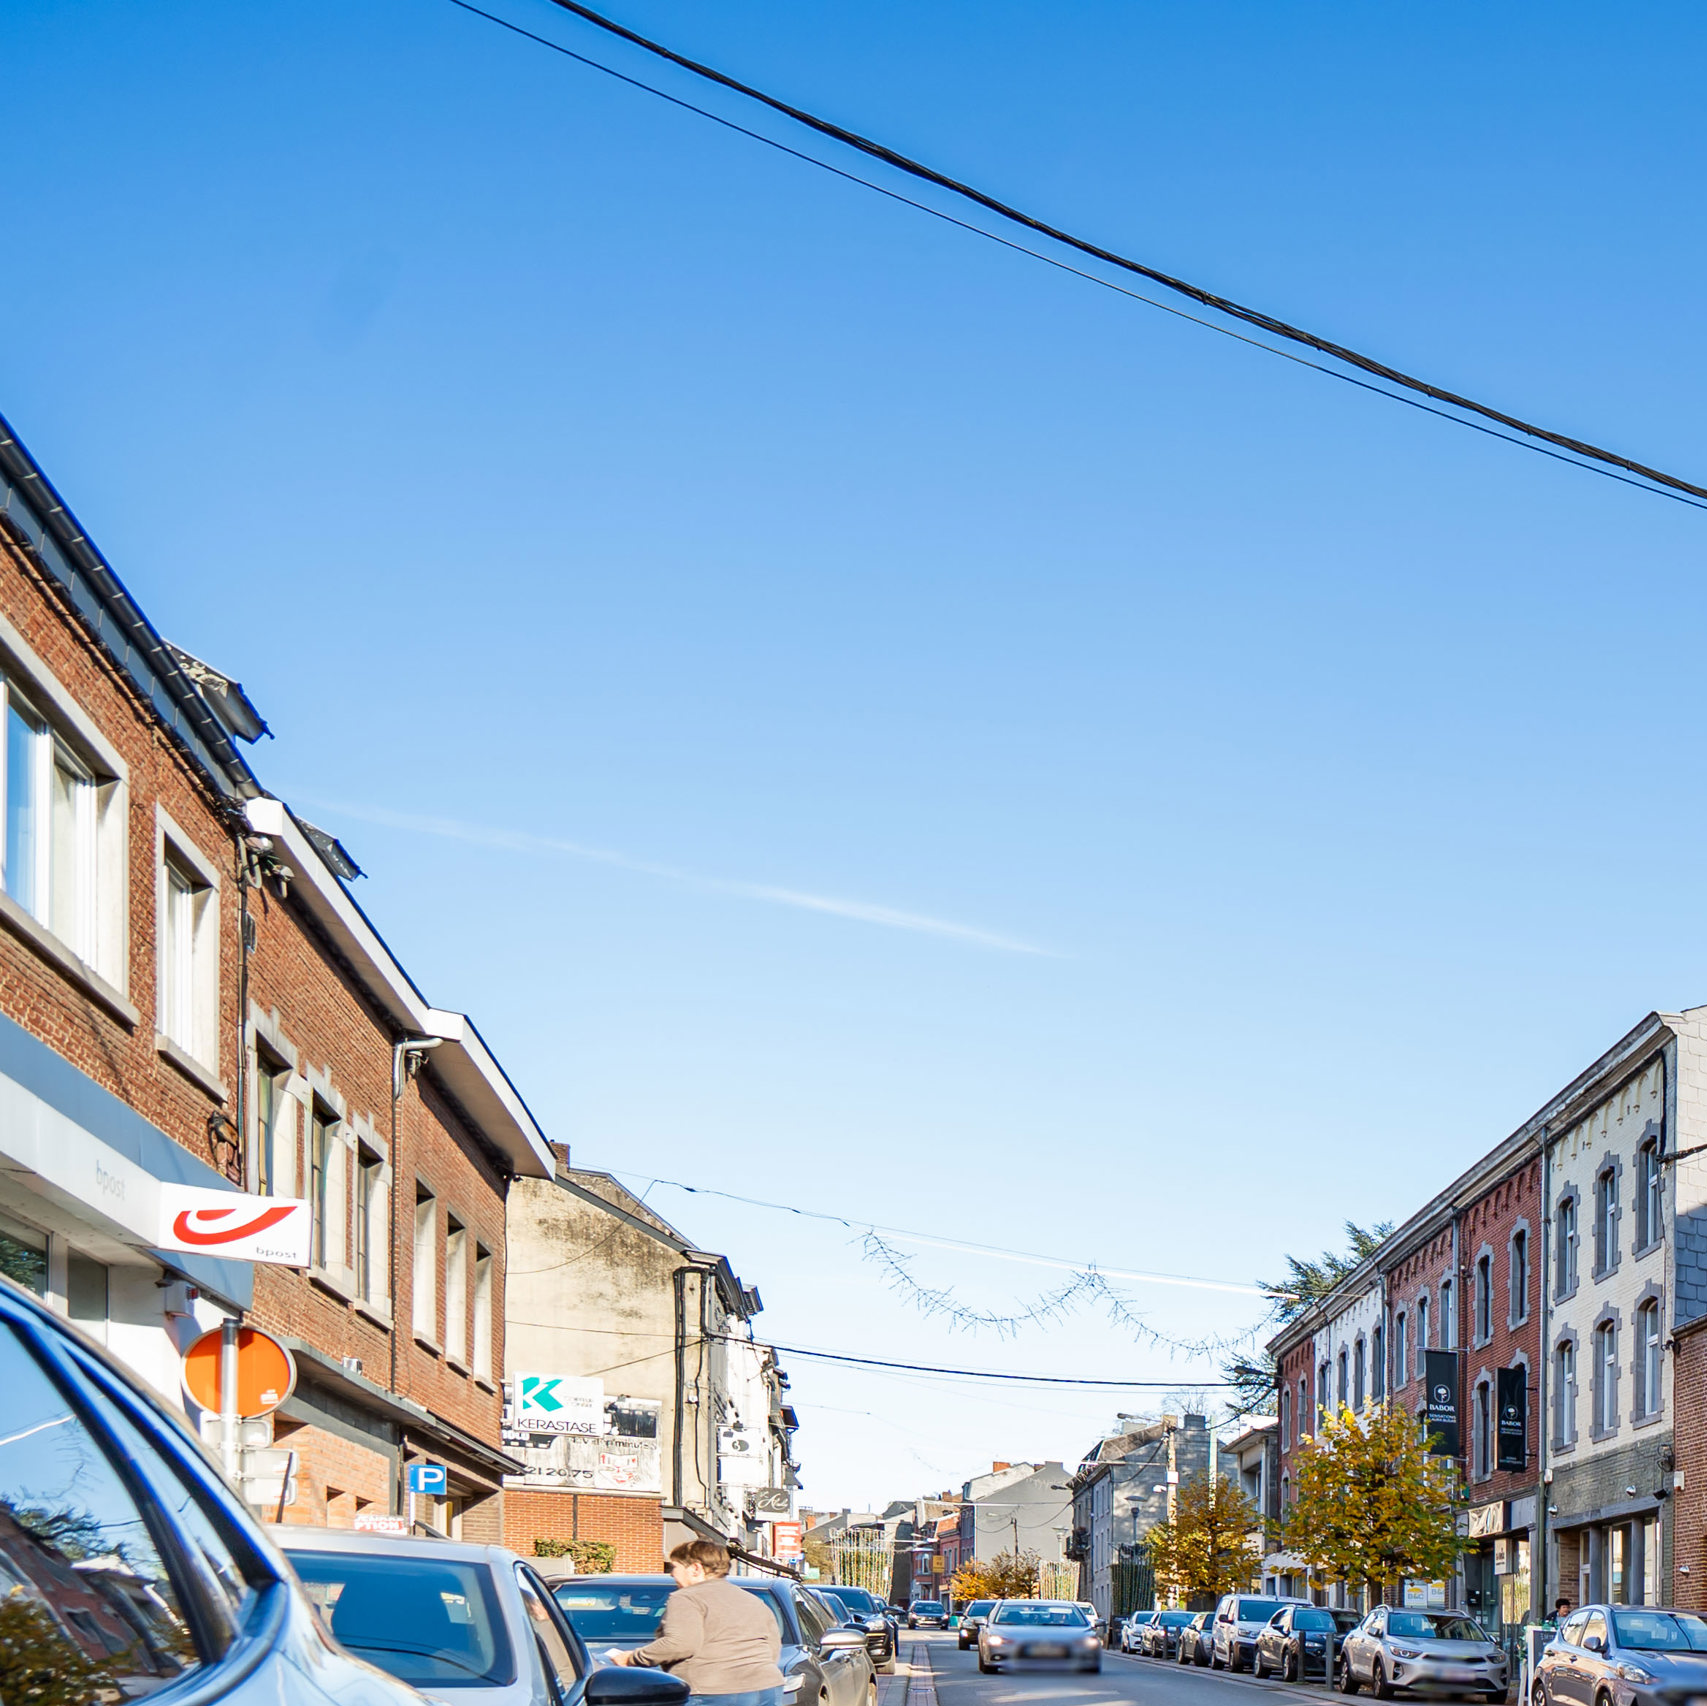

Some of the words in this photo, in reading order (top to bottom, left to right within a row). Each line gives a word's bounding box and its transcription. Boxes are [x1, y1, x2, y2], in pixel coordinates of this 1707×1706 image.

[96, 1159, 126, 1201] bpost
[256, 1246, 297, 1260] bpost
[1429, 1403, 1455, 1412] BABOR
[517, 1418, 597, 1434] KERASTASE
[418, 1467, 444, 1491] P
